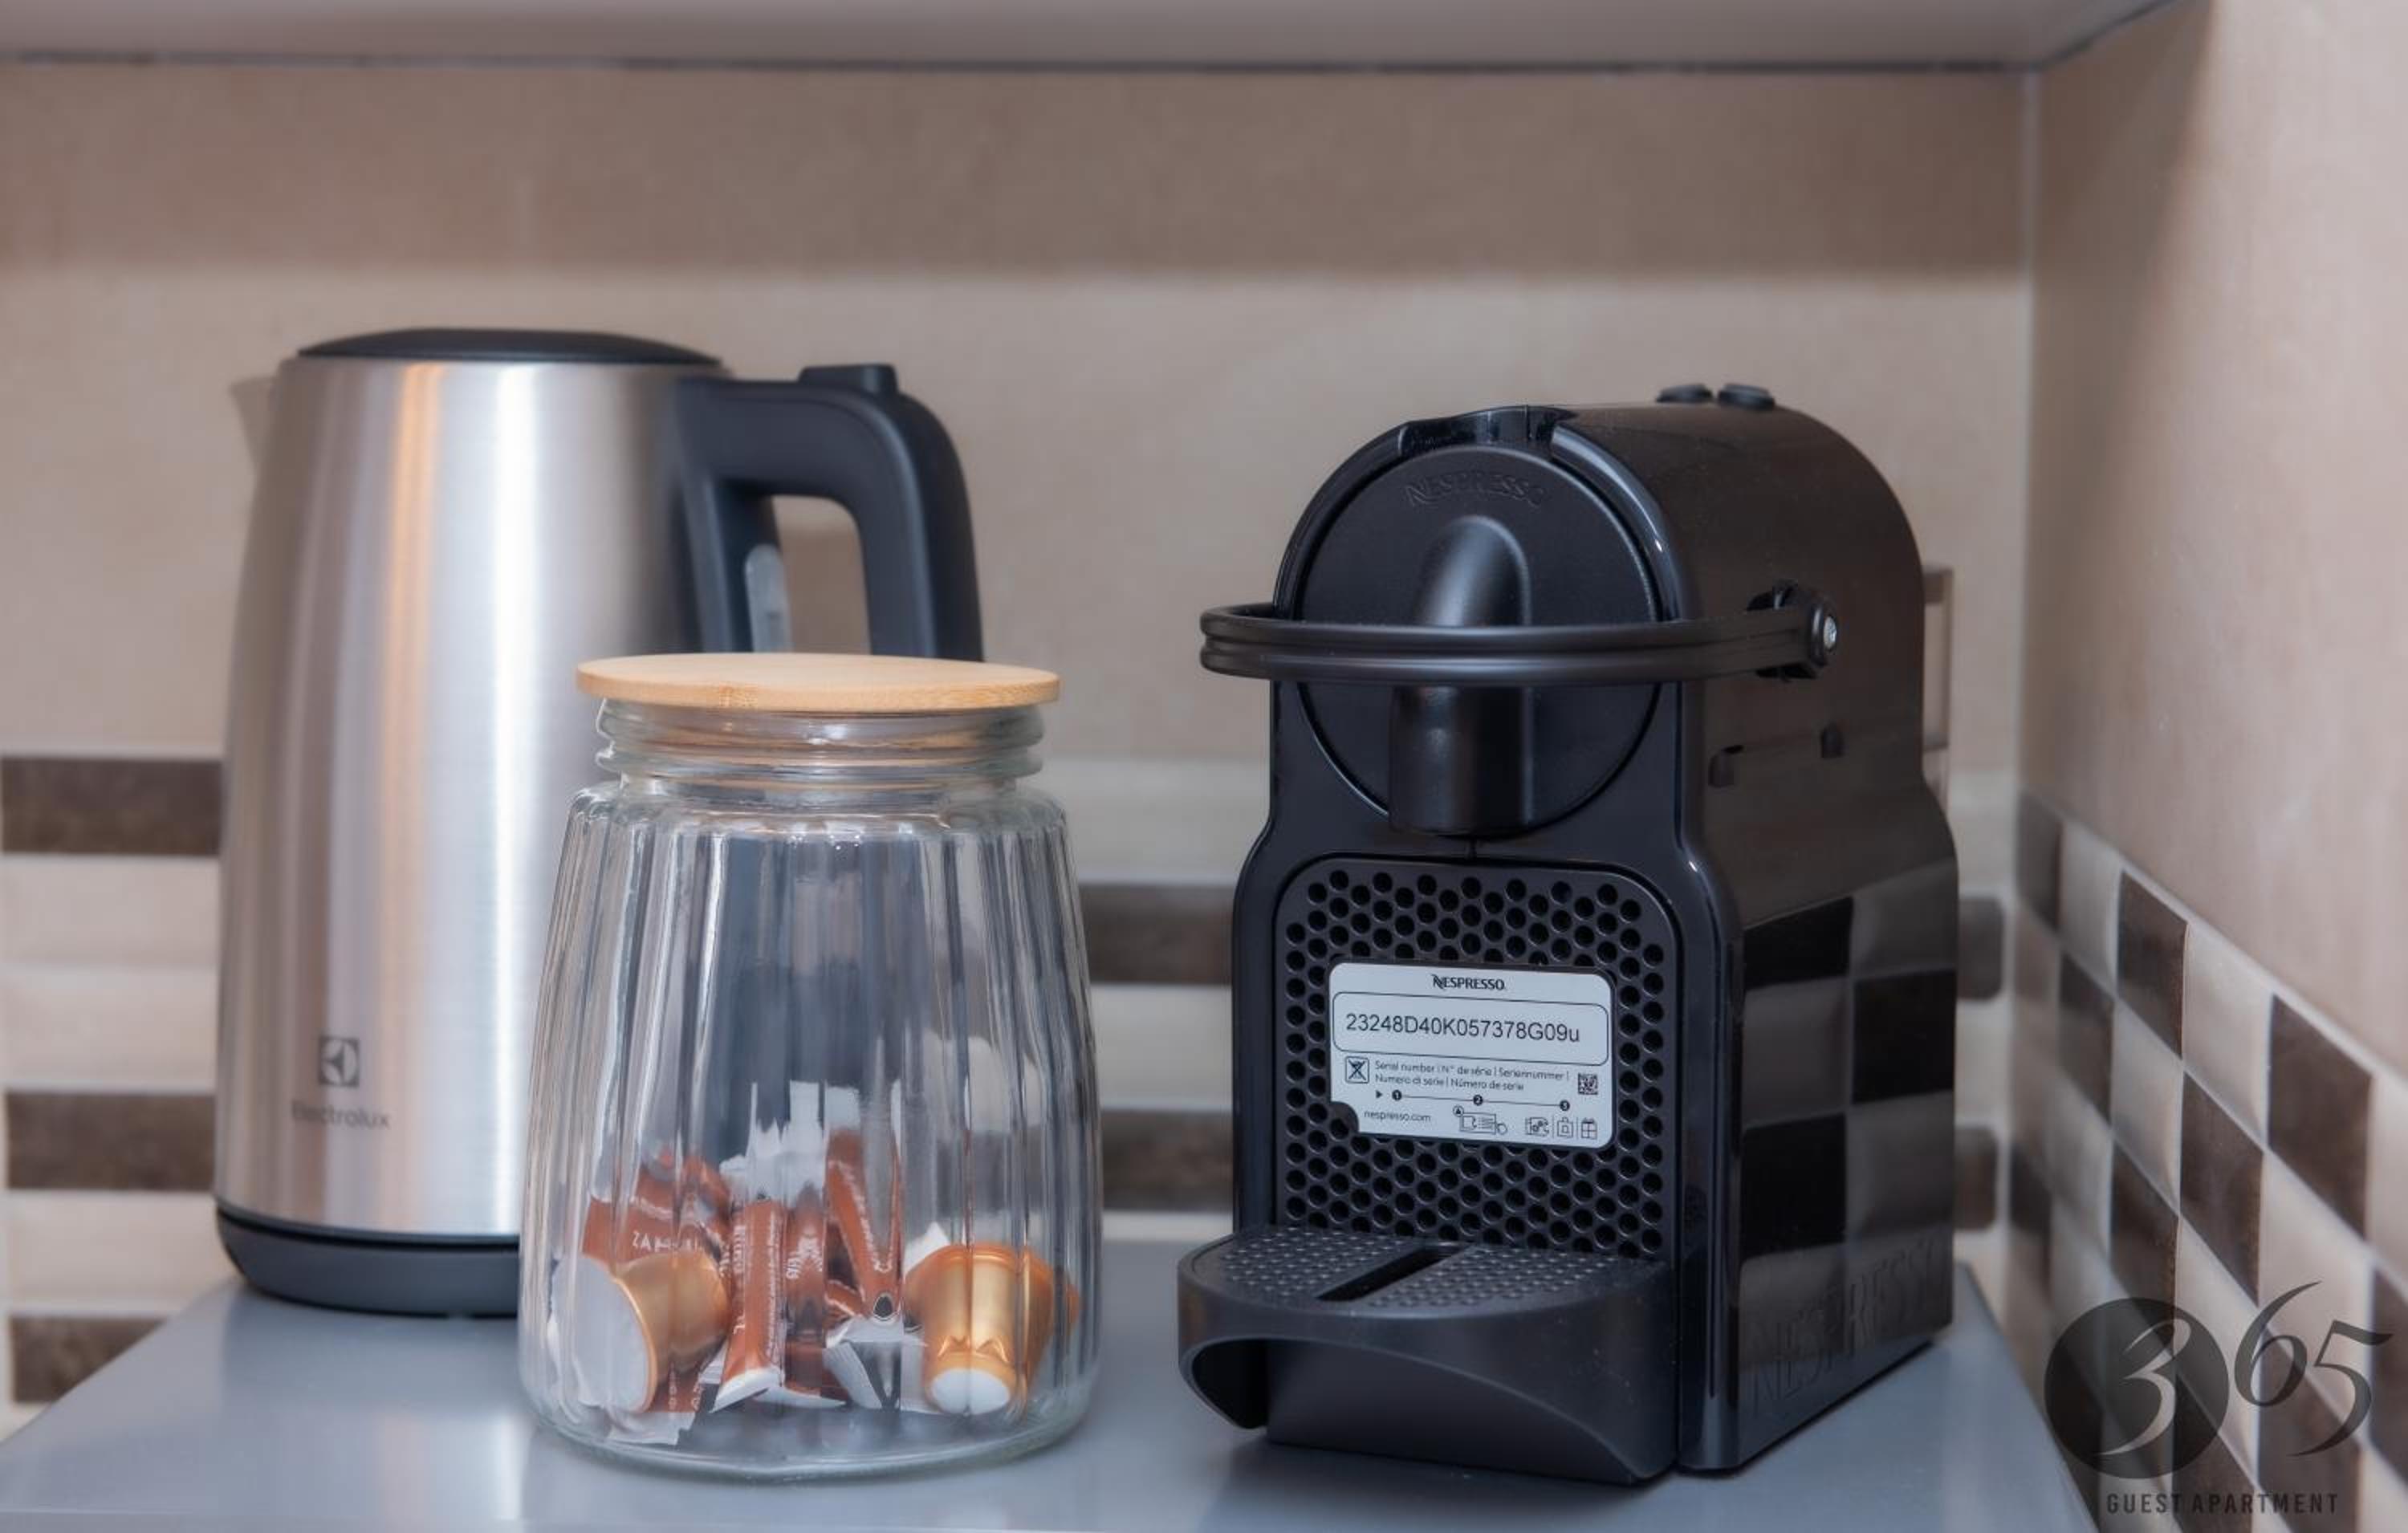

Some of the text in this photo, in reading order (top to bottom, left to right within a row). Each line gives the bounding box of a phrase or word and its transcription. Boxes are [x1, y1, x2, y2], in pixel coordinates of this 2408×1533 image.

[1404, 471, 1545, 511] NESPRESSO
[1346, 1013, 1580, 1043] 23248D40K057378G09u
[1401, 1063, 1434, 1072] number
